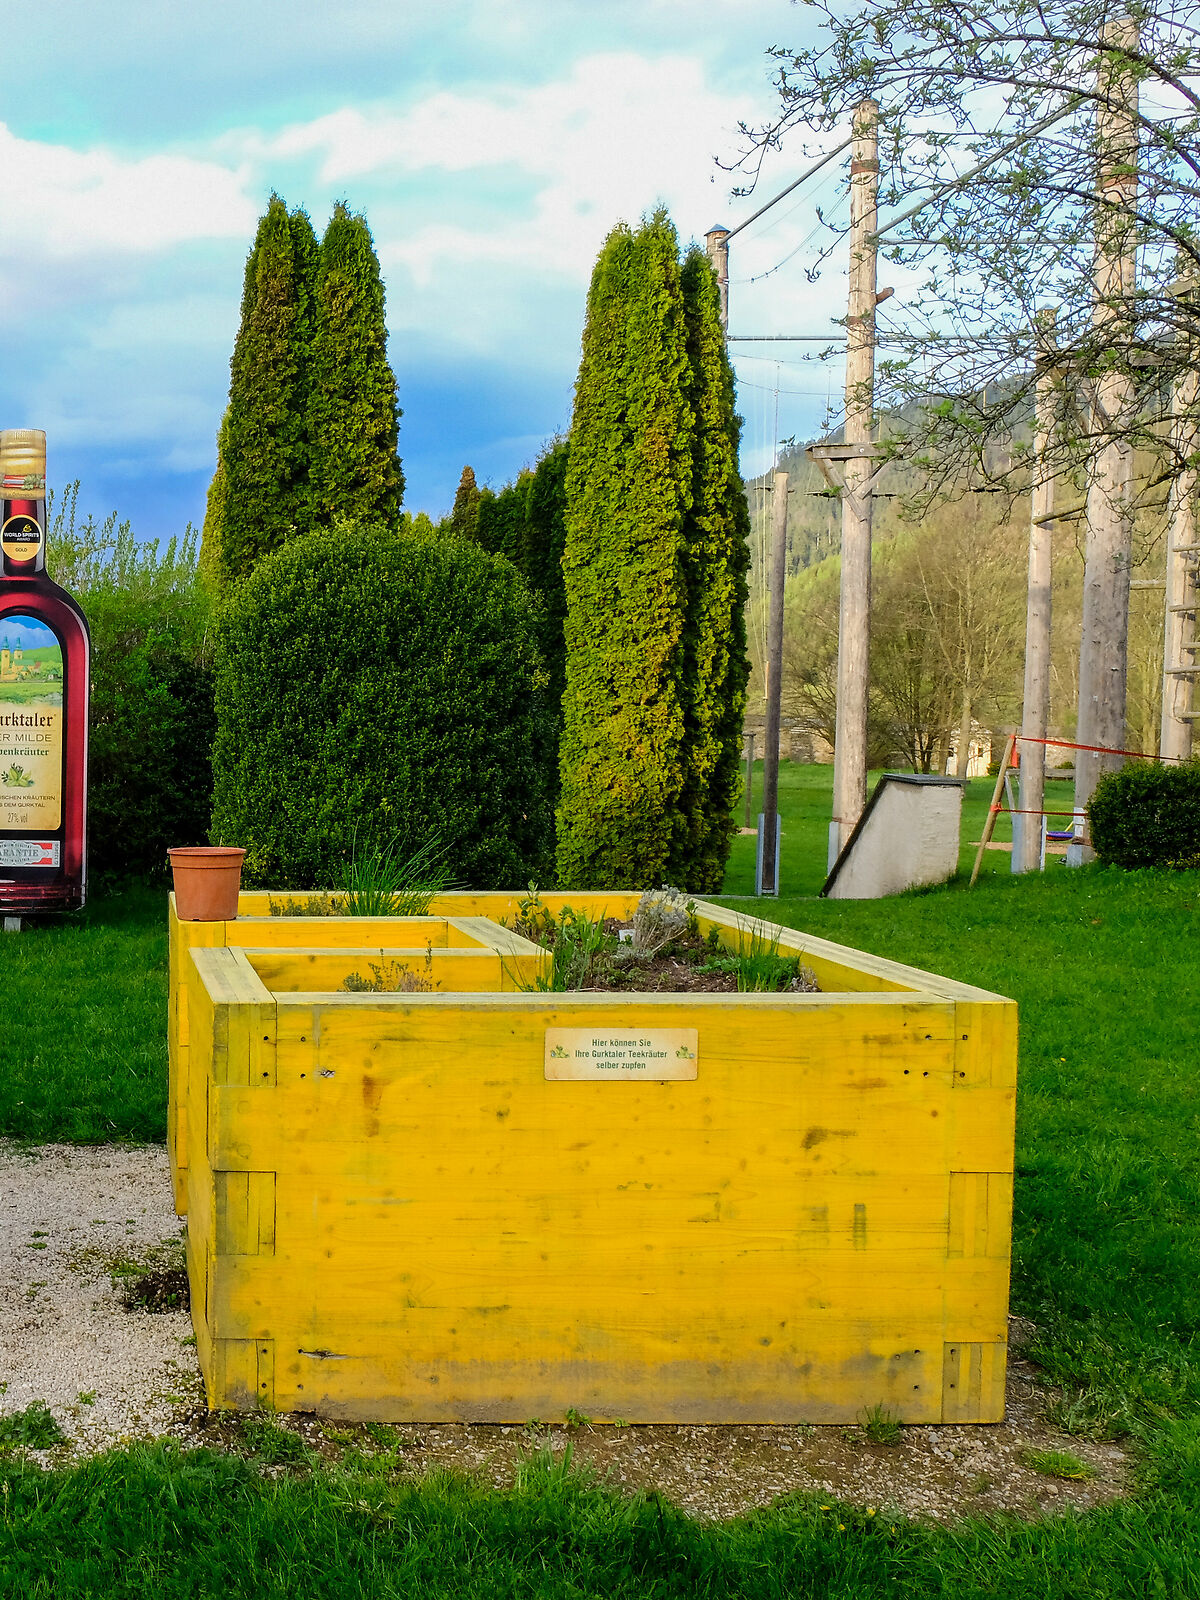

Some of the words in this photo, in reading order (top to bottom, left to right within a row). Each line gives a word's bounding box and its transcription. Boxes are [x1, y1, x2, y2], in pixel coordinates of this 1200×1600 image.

[15, 734, 52, 742] MILDE
[8, 812, 19, 823] 27%
[621, 1061, 646, 1070] zupfen
